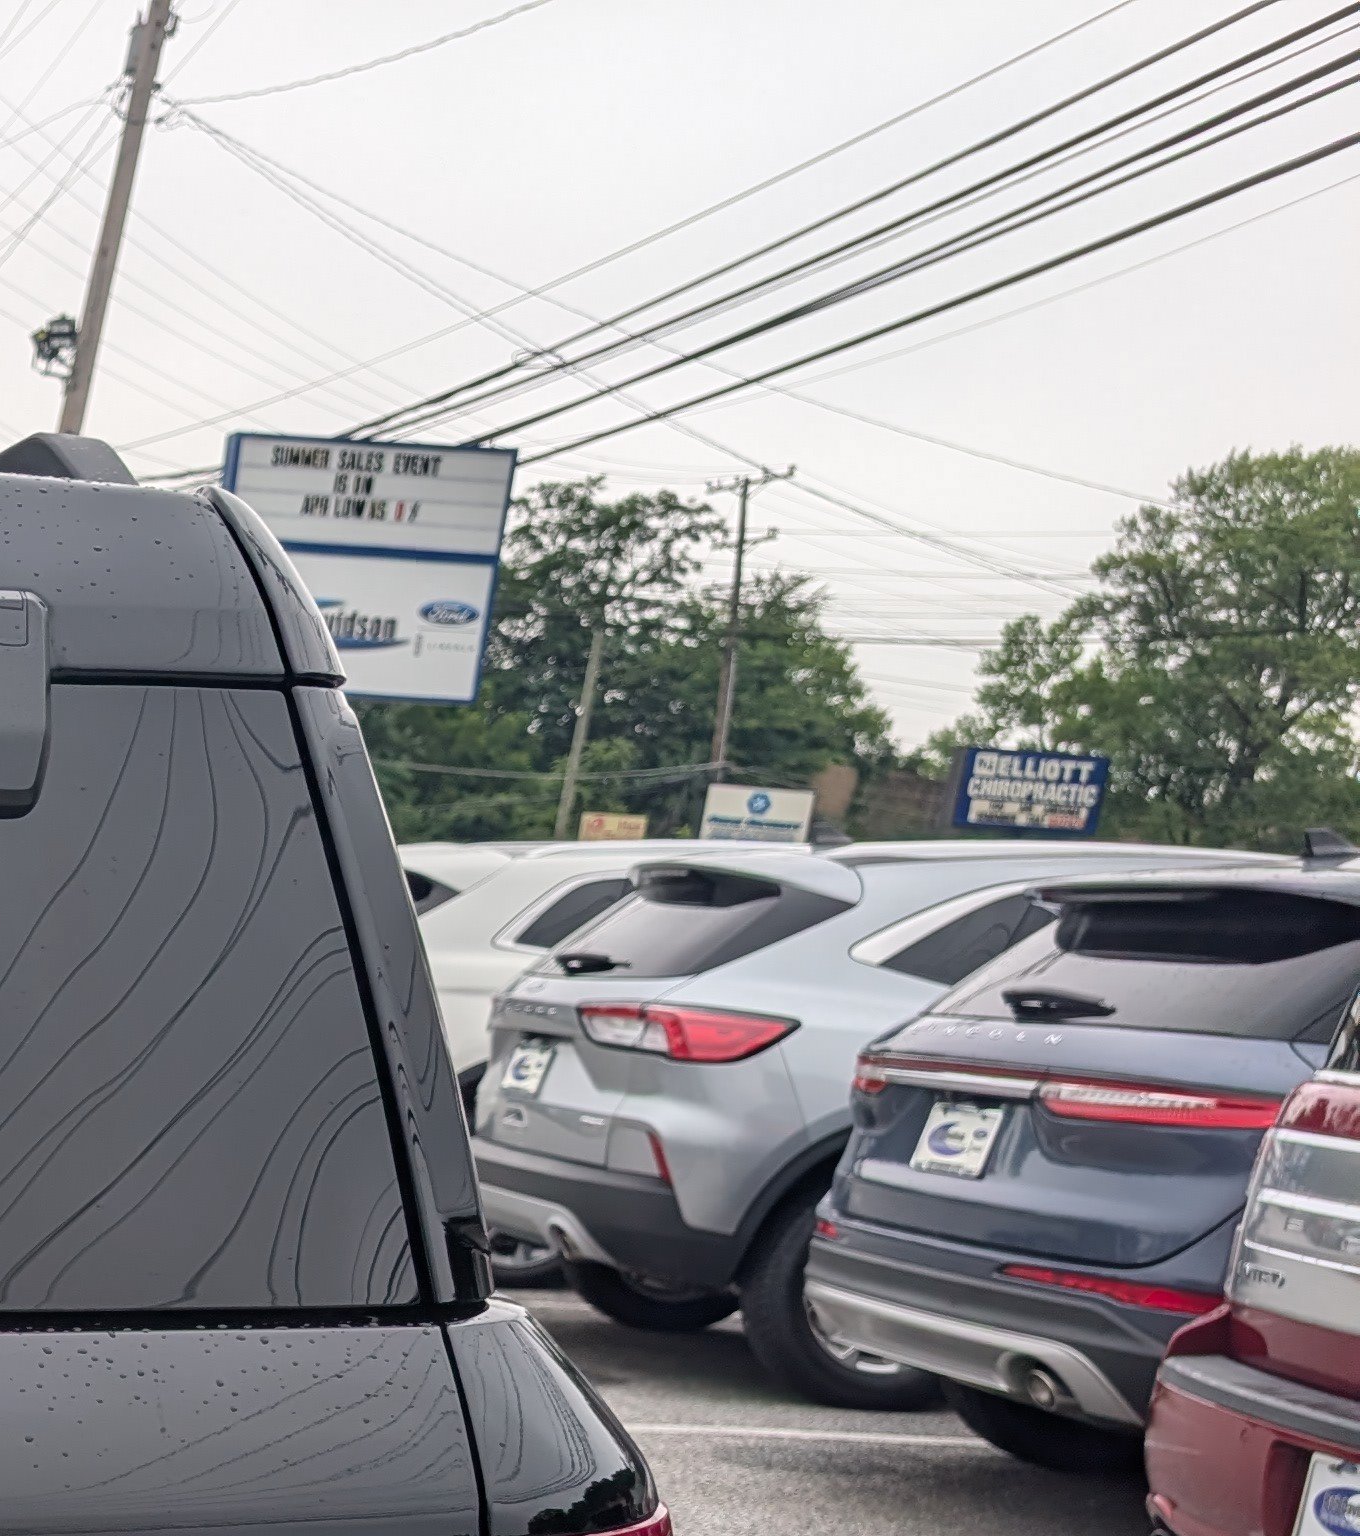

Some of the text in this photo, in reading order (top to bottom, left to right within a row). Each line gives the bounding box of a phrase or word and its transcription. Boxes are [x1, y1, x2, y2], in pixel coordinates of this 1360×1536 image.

[271, 445, 442, 477] SUMMER SALES EVENT
[325, 609, 396, 638] vidson
[998, 755, 1096, 782] ELLIOTT
[967, 777, 1100, 807] CHIROPRACTIC
